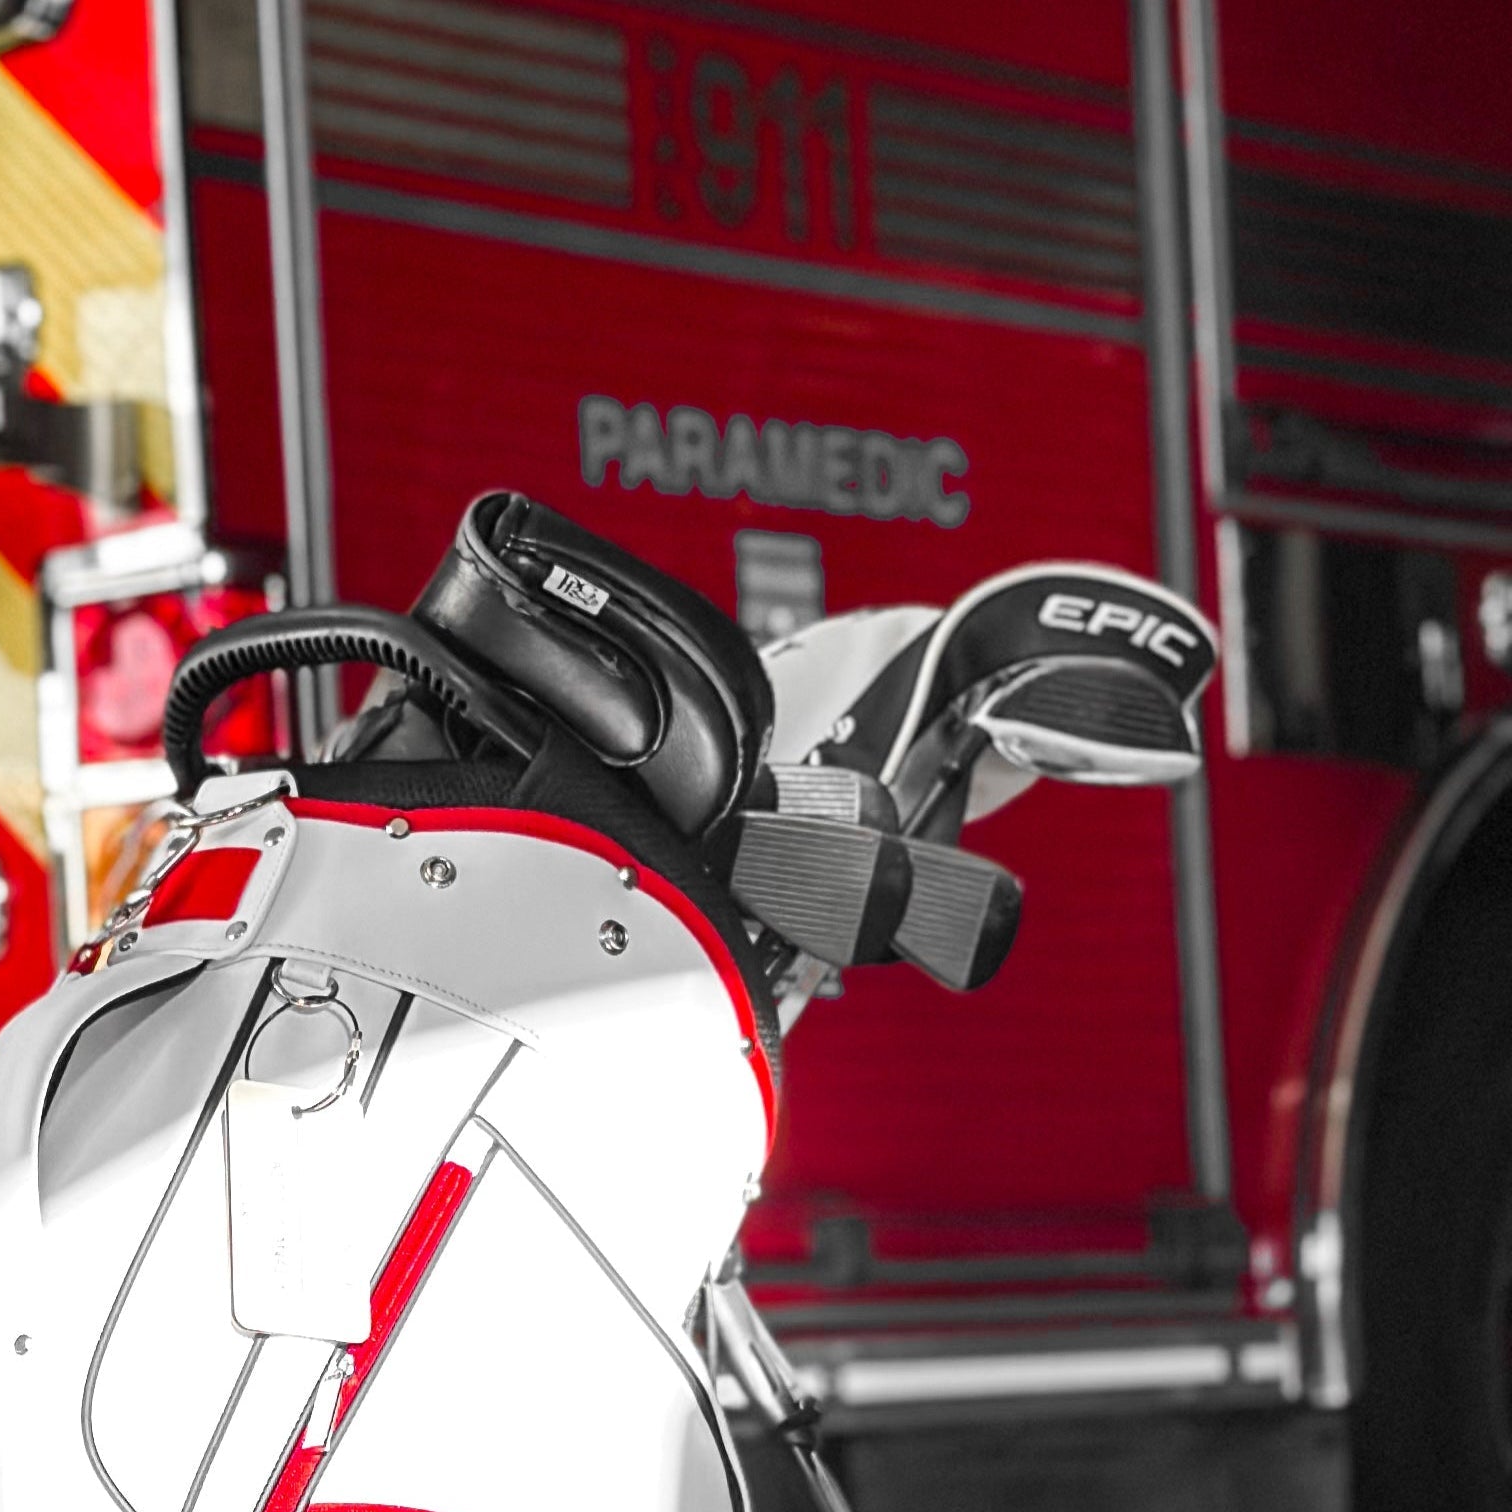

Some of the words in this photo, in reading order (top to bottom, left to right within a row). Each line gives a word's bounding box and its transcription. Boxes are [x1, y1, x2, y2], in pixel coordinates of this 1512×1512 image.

[692, 52, 855, 248] 911
[578, 395, 970, 529] PARAMEDIC
[1038, 593, 1198, 668] EPIC
